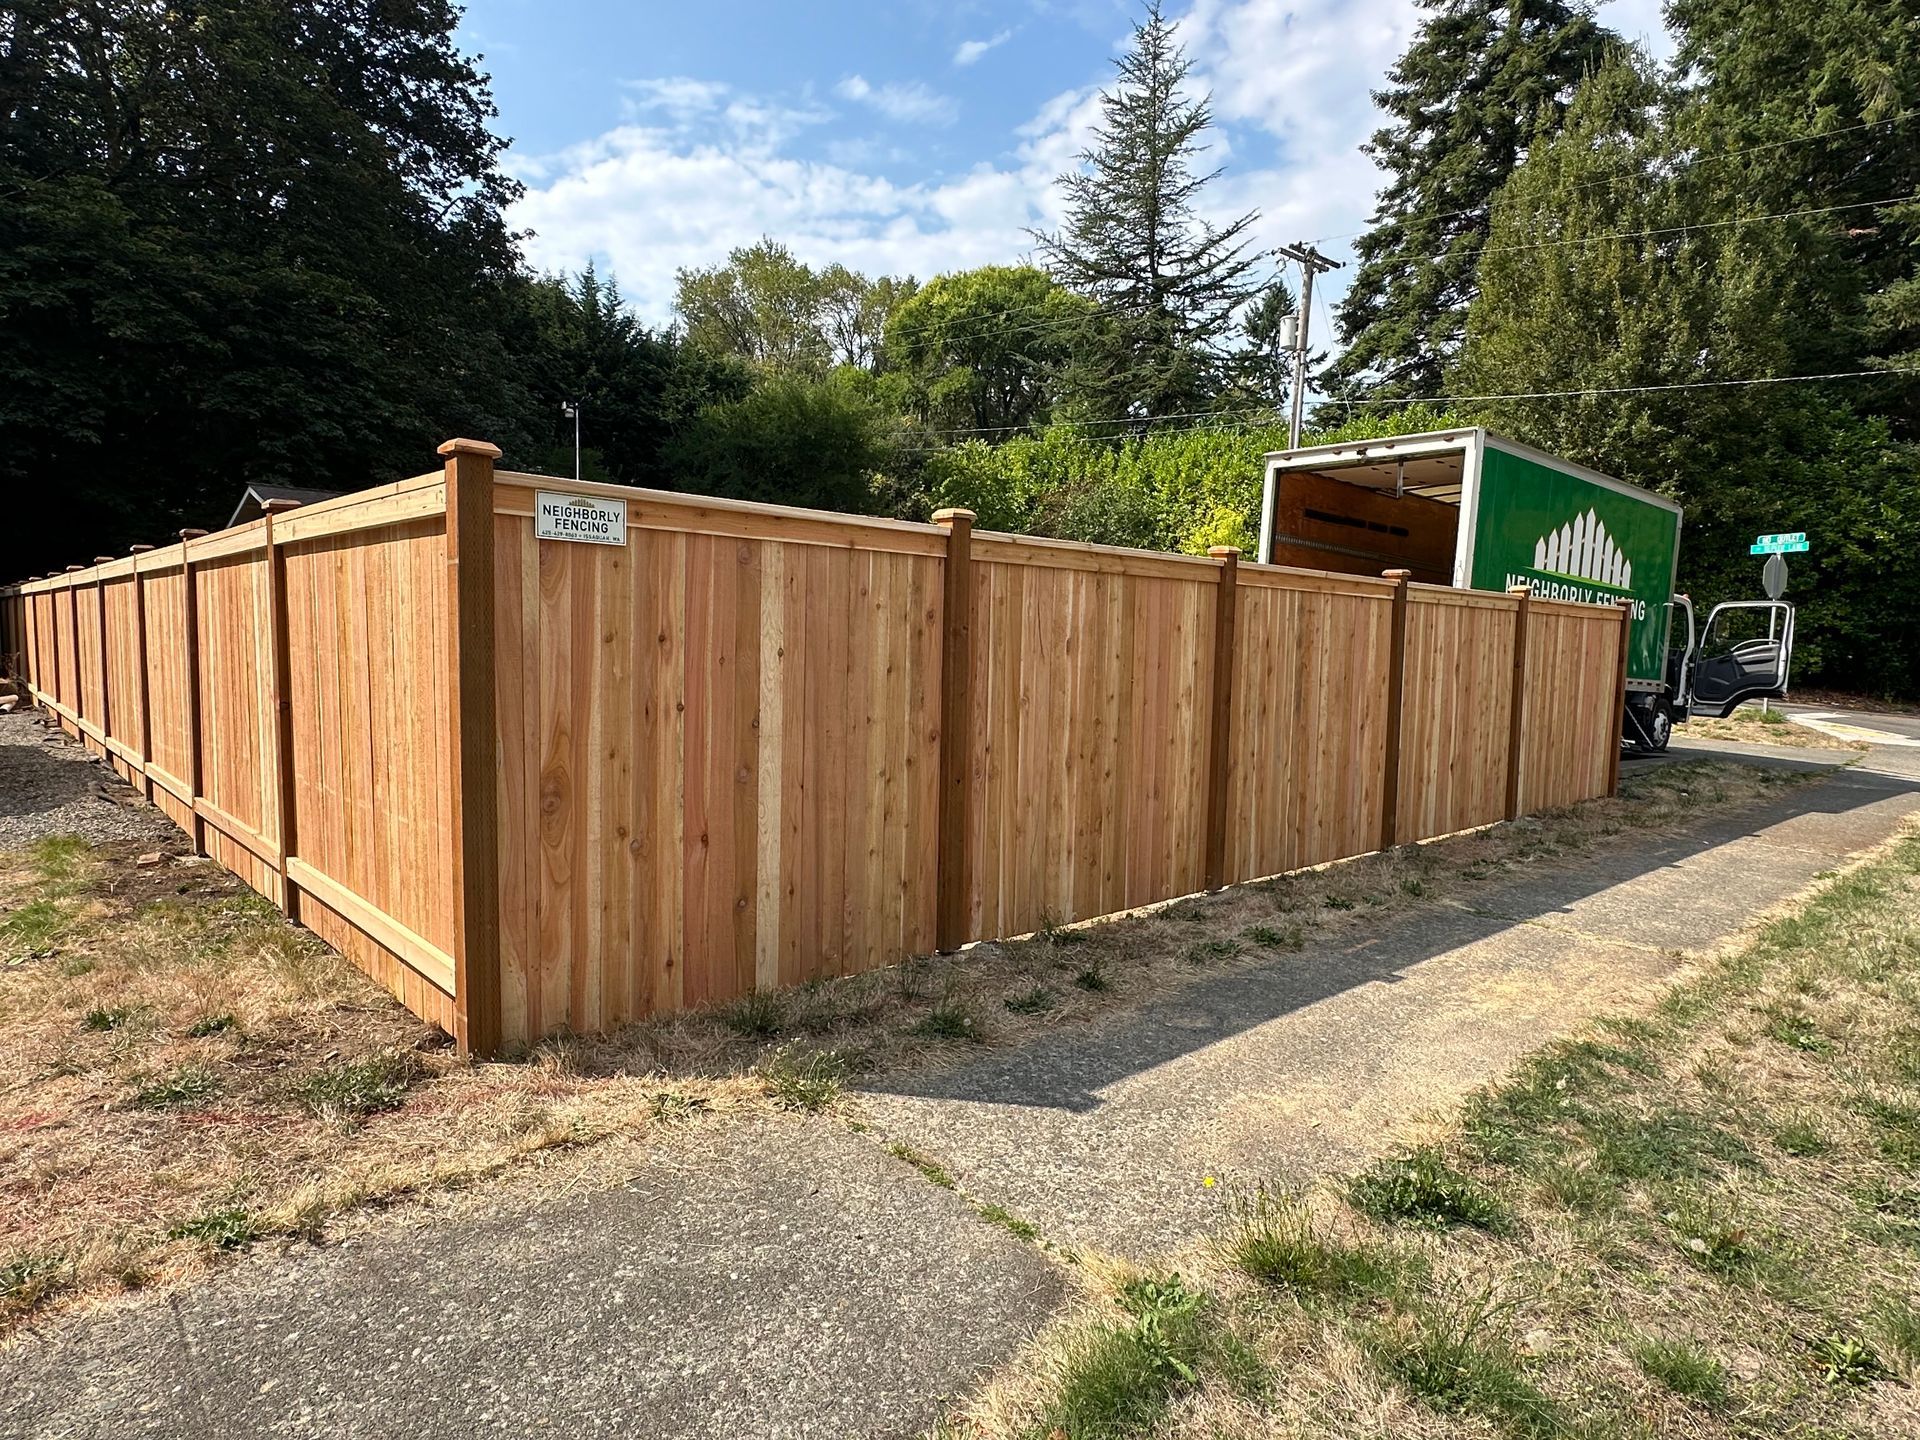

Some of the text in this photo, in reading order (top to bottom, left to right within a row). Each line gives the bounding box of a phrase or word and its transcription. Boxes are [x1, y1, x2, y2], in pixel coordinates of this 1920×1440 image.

[543, 504, 620, 523] NEIGHBORLY
[555, 518, 609, 533] FENCING
[1596, 592, 1646, 621] FENNG
